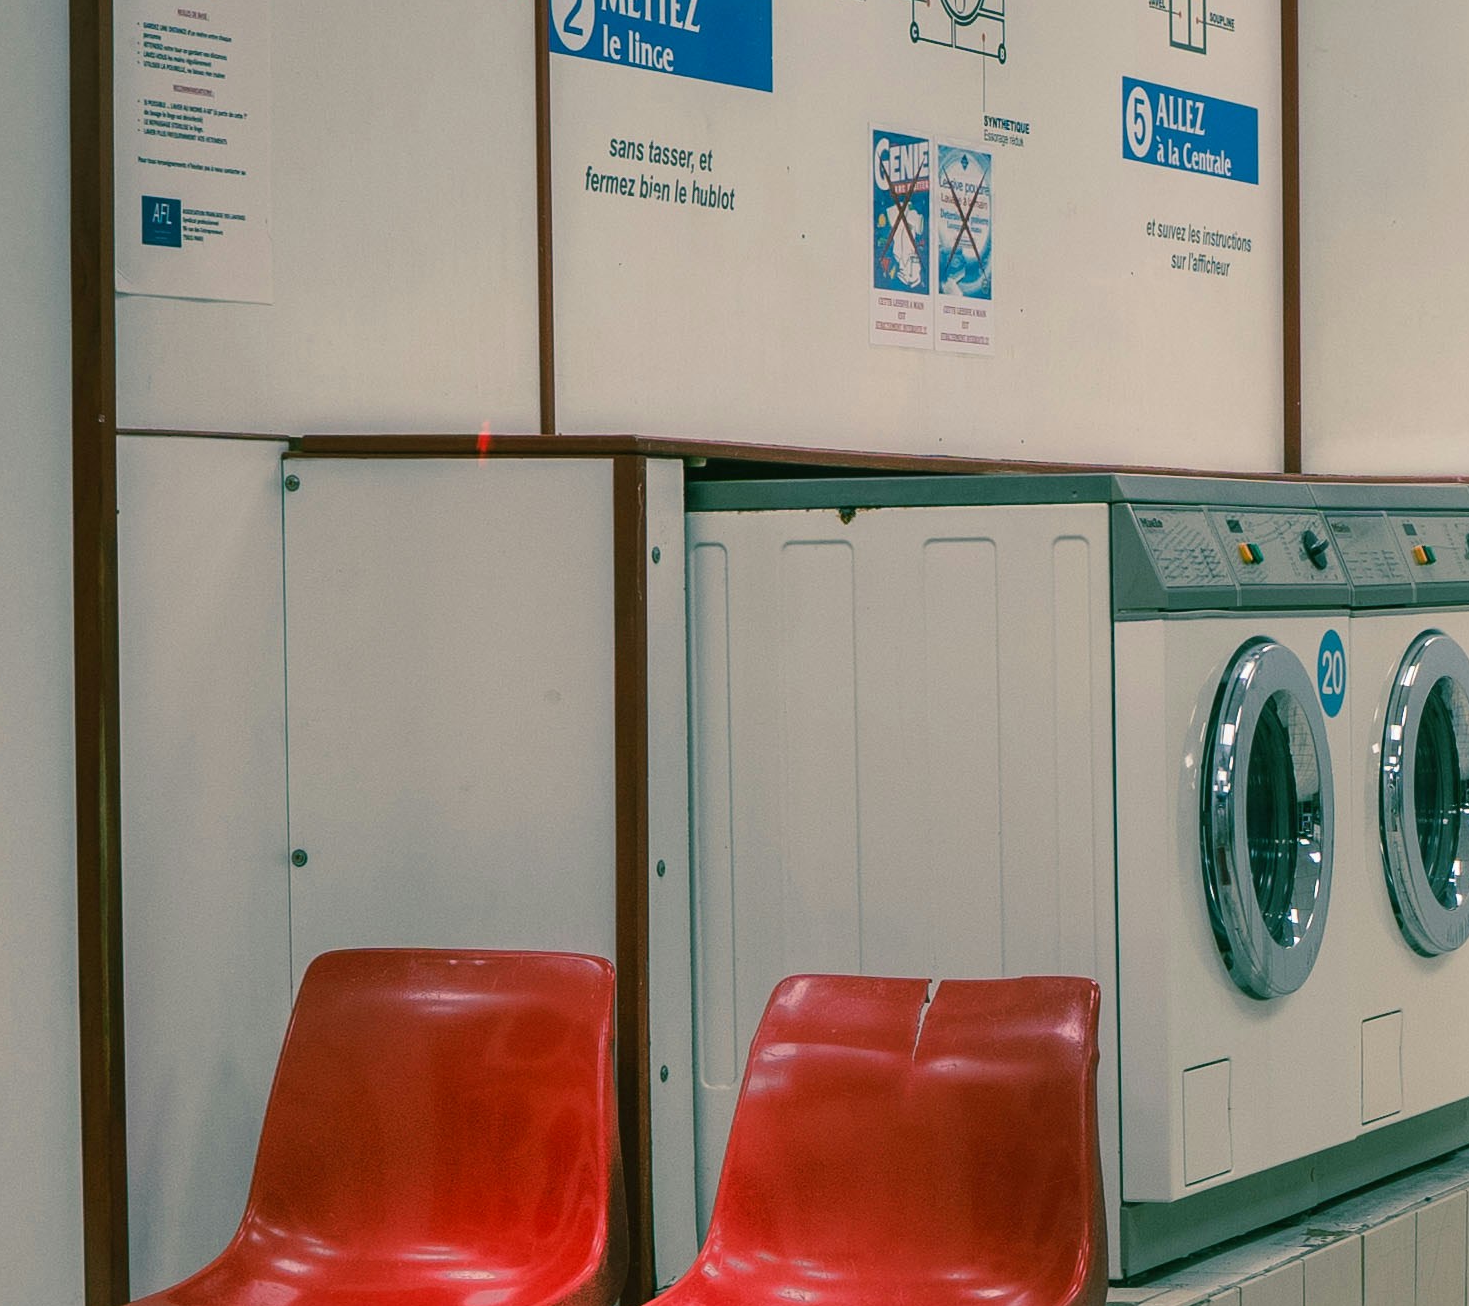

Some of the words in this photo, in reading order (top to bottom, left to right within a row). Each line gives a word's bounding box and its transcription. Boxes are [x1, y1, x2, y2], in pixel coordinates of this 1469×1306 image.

[1209, 11, 1235, 29] SOUPLINE
[602, 24, 621, 60] le
[983, 115, 1030, 134] SYNTHETIQUE
[1134, 97, 1146, 146] 5
[1156, 93, 1205, 135] ALLEZ
[609, 137, 644, 161] sans
[649, 139, 695, 174] tasser,
[699, 150, 713, 172] et
[874, 137, 929, 191] GENIE
[1156, 136, 1164, 163] à
[1168, 139, 1179, 167] la
[1183, 142, 1231, 177] Centrale
[585, 166, 635, 197] fermez
[640, 174, 670, 202] bien
[674, 179, 687, 204] le
[692, 180, 735, 211] hublot
[1146, 219, 1156, 237] et
[1158, 220, 1186, 242] suivez
[1188, 223, 1201, 244] les
[1203, 226, 1252, 252] instructions
[1171, 253, 1186, 271] sur
[1187, 252, 1230, 278] l'afficheur
[1322, 650, 1343, 695] 20
